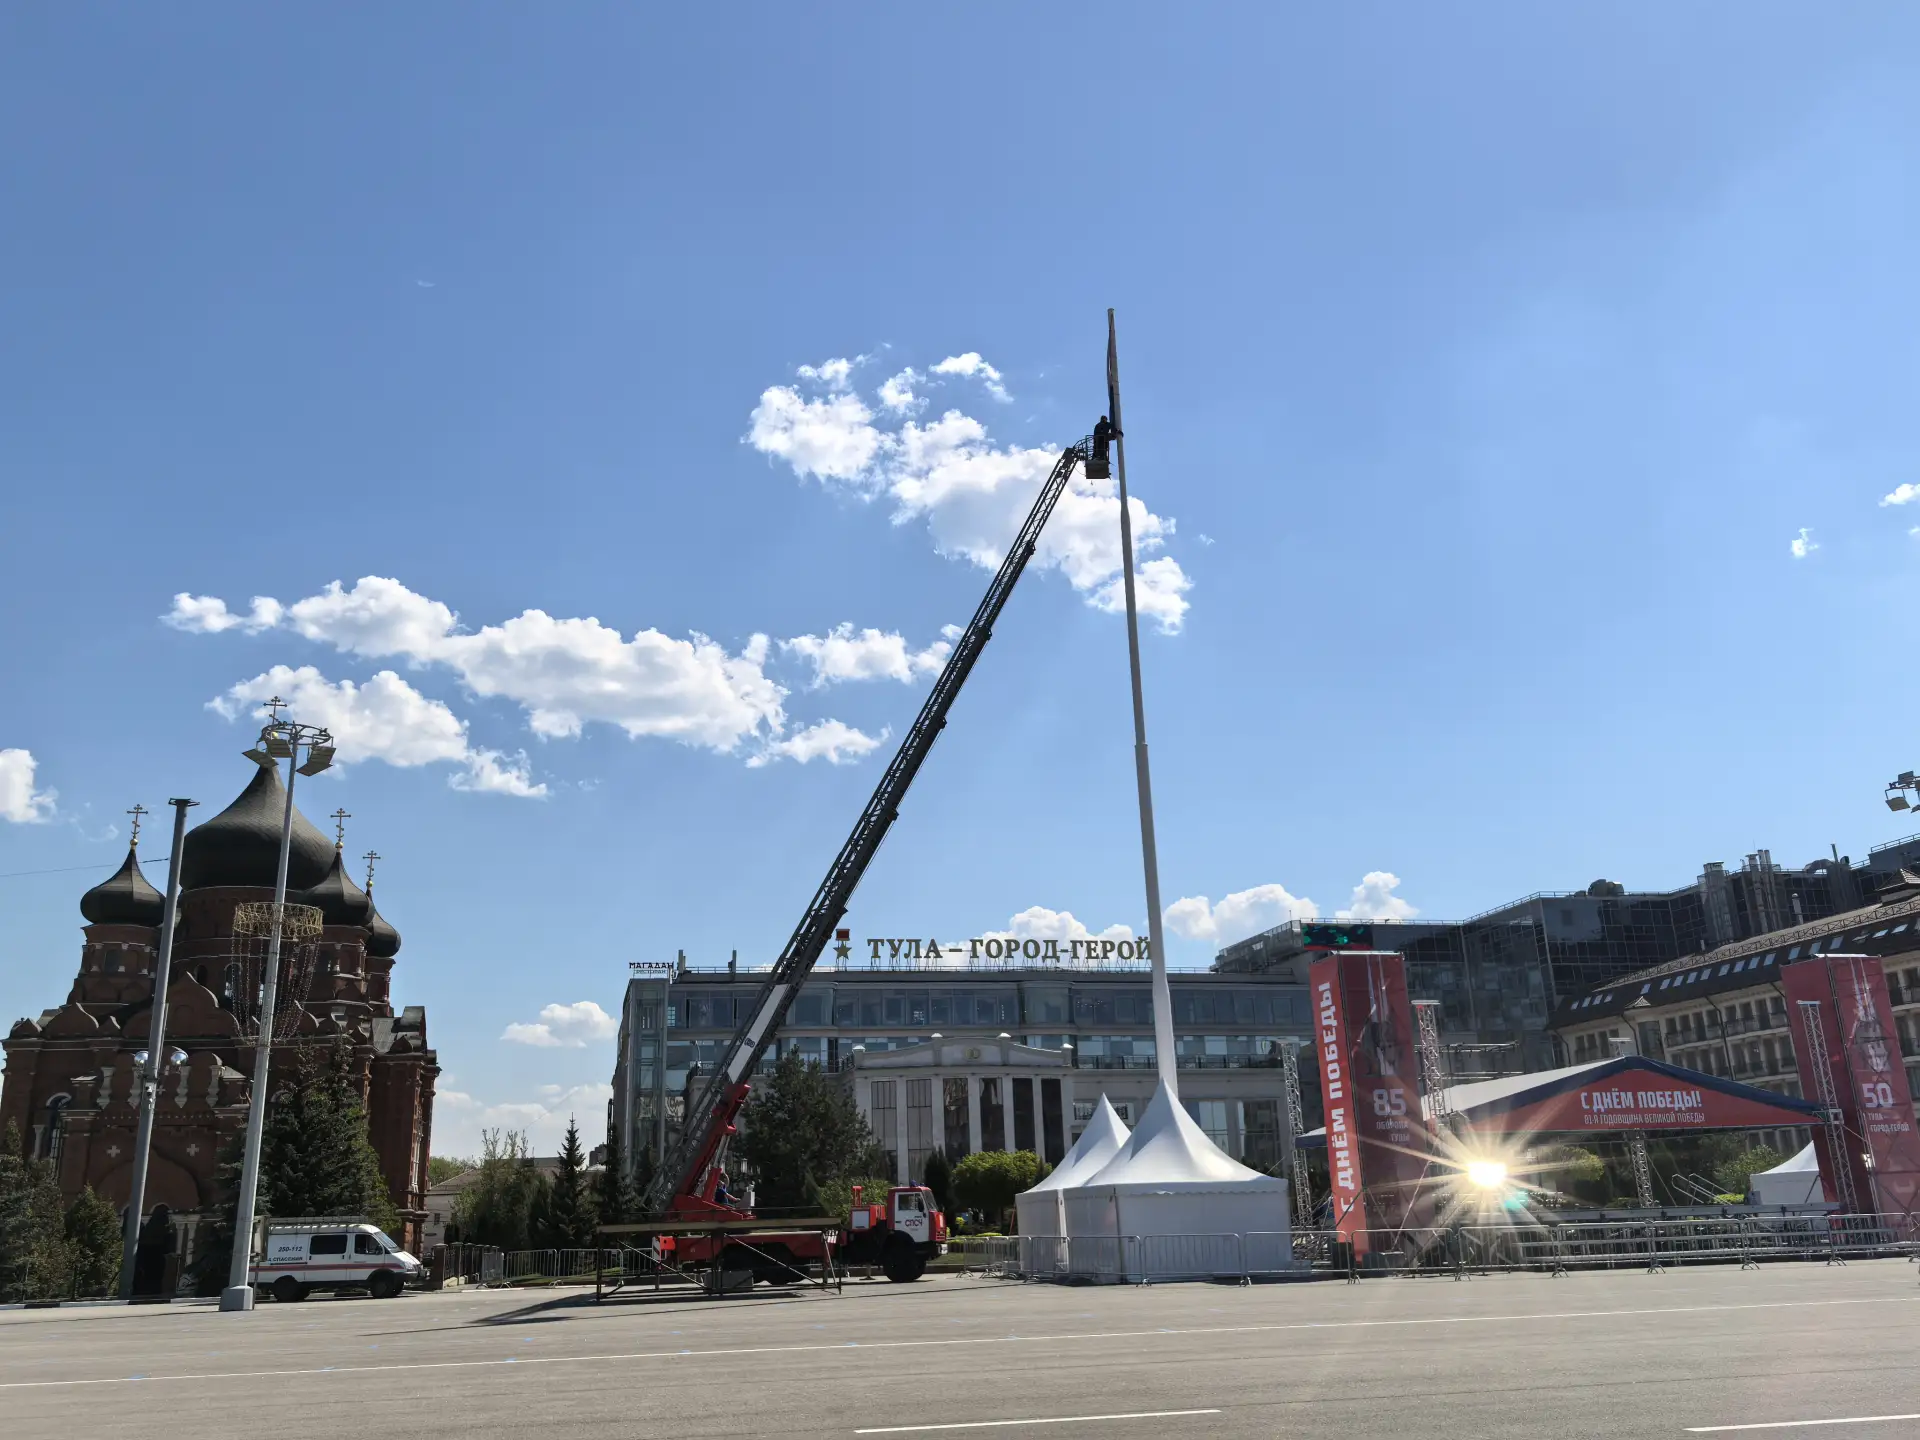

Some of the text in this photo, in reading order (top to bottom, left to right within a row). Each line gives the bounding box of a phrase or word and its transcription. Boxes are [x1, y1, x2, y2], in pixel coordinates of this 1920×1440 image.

[867, 939, 943, 959] ТУЛА
[969, 935, 1151, 963] ГОРОД-ГЕРОЙ
[629, 961, 674, 969] МАГАДАН
[1319, 982, 1355, 1212] С ДНЁМ ПОБЕДЫ
[1373, 1088, 1407, 1116] 85
[1580, 1088, 1702, 1112] С ДНЁМ ПОБЕДЫ!
[1862, 1082, 1893, 1108] 50
[1600, 1113, 1643, 1126] ГОДОВЩИНА
[1645, 1111, 1675, 1124] ВЕЛИКОЙ
[1677, 1112, 1705, 1124] ПОБЕДЫ
